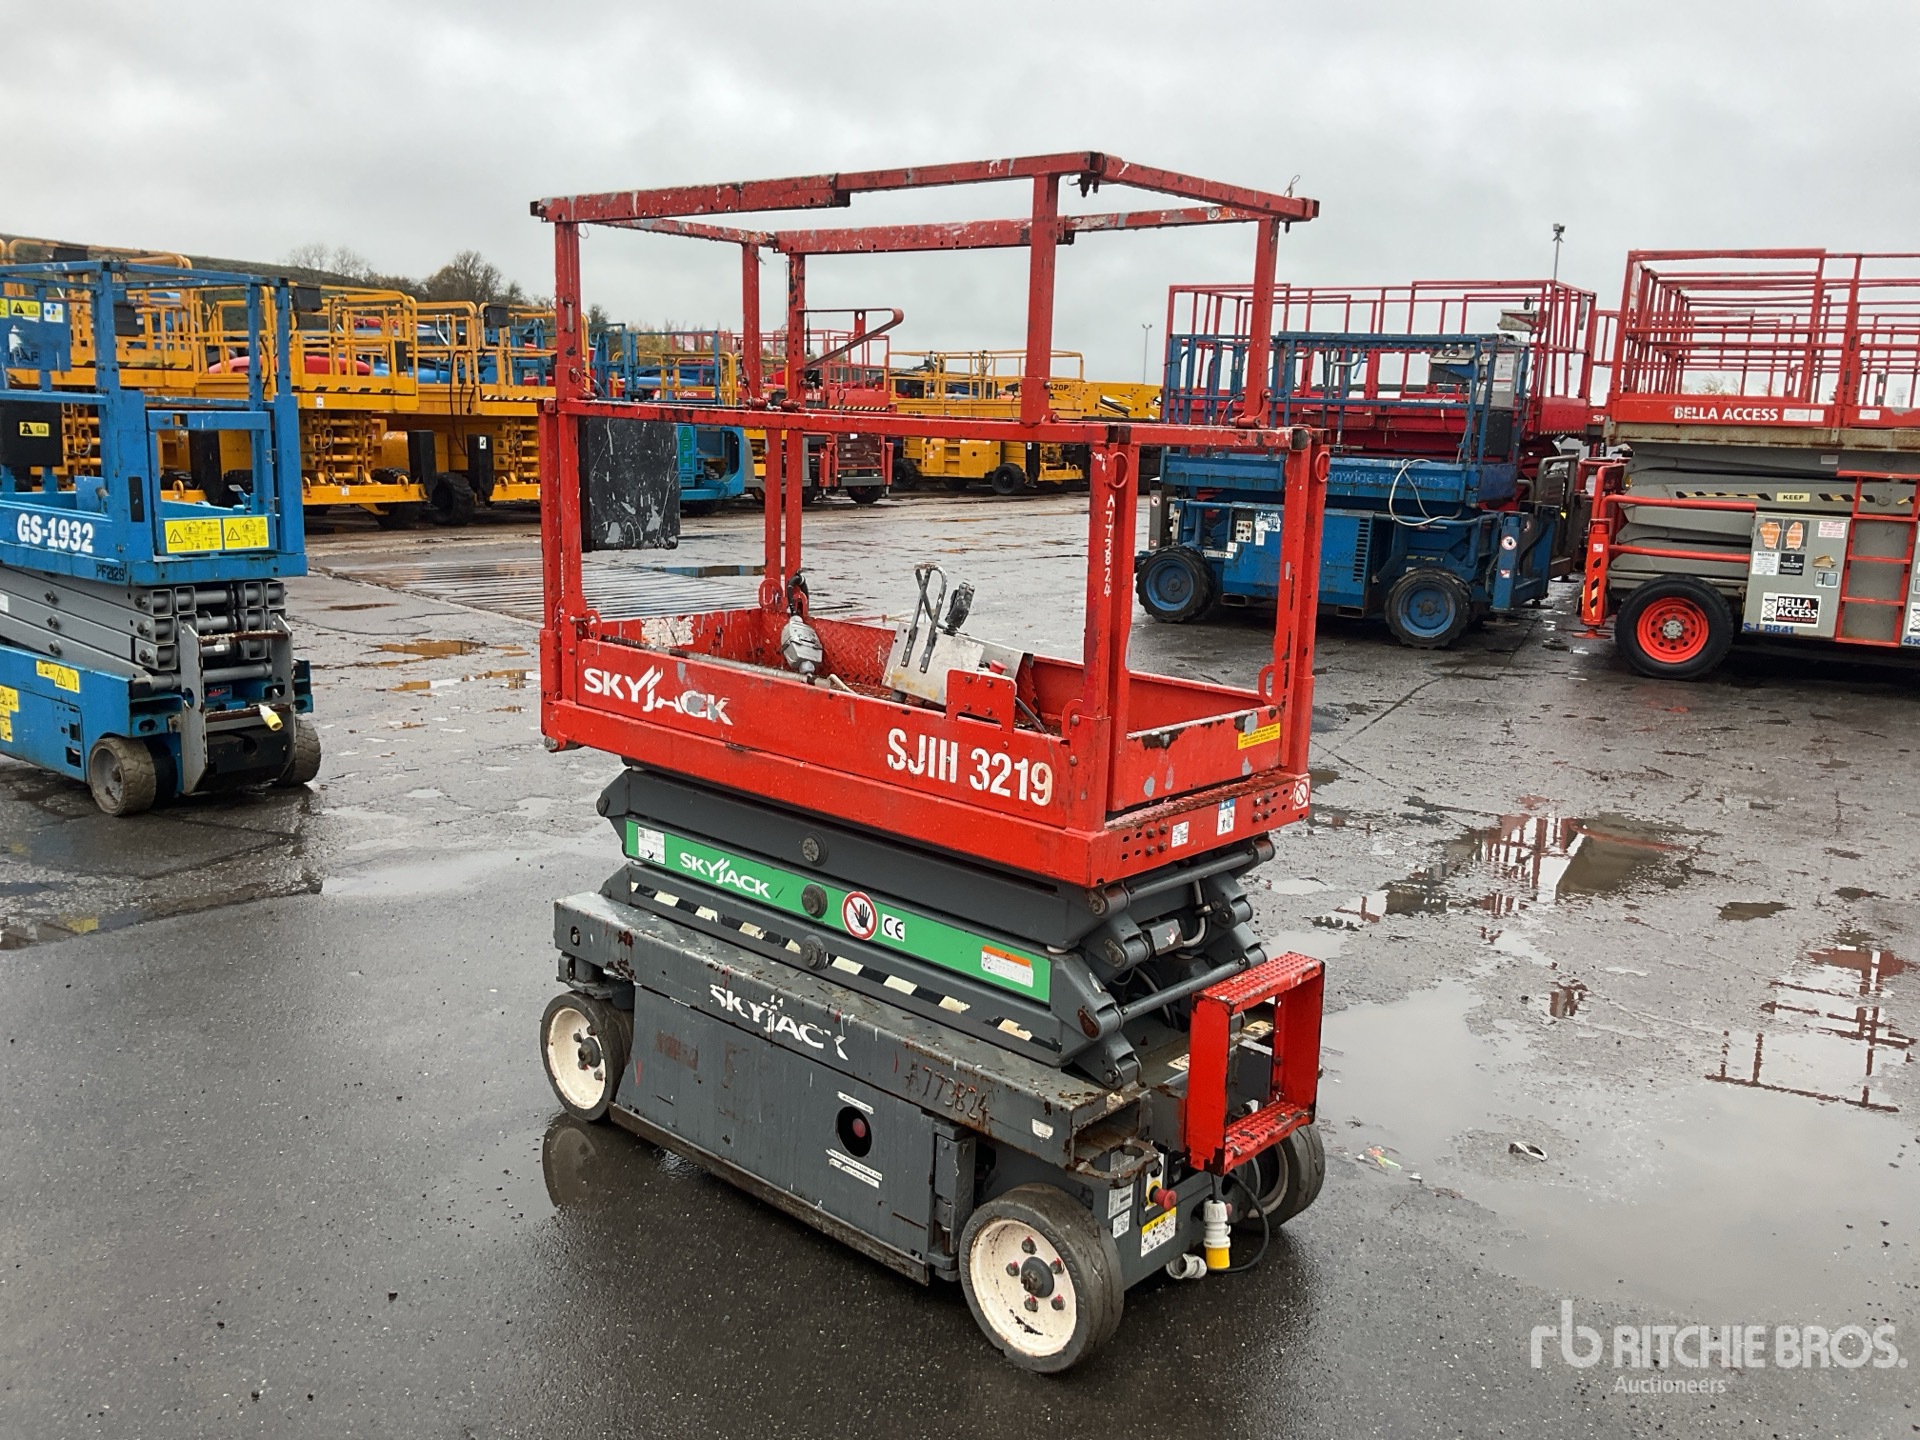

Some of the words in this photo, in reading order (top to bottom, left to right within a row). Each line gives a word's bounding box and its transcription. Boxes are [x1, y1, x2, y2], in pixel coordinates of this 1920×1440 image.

[1673, 406, 1718, 420] BELLA
[1722, 408, 1779, 421] ACCESS
[17, 512, 94, 554] GS-1932
[1776, 607, 1818, 619] ACCESS
[1777, 597, 1812, 609] BELLA
[1764, 624, 1794, 634] 8841
[583, 665, 734, 726] SKYJACK
[969, 747, 1053, 807] 3219
[680, 852, 772, 900] SKYJACK
[883, 917, 904, 940] CE
